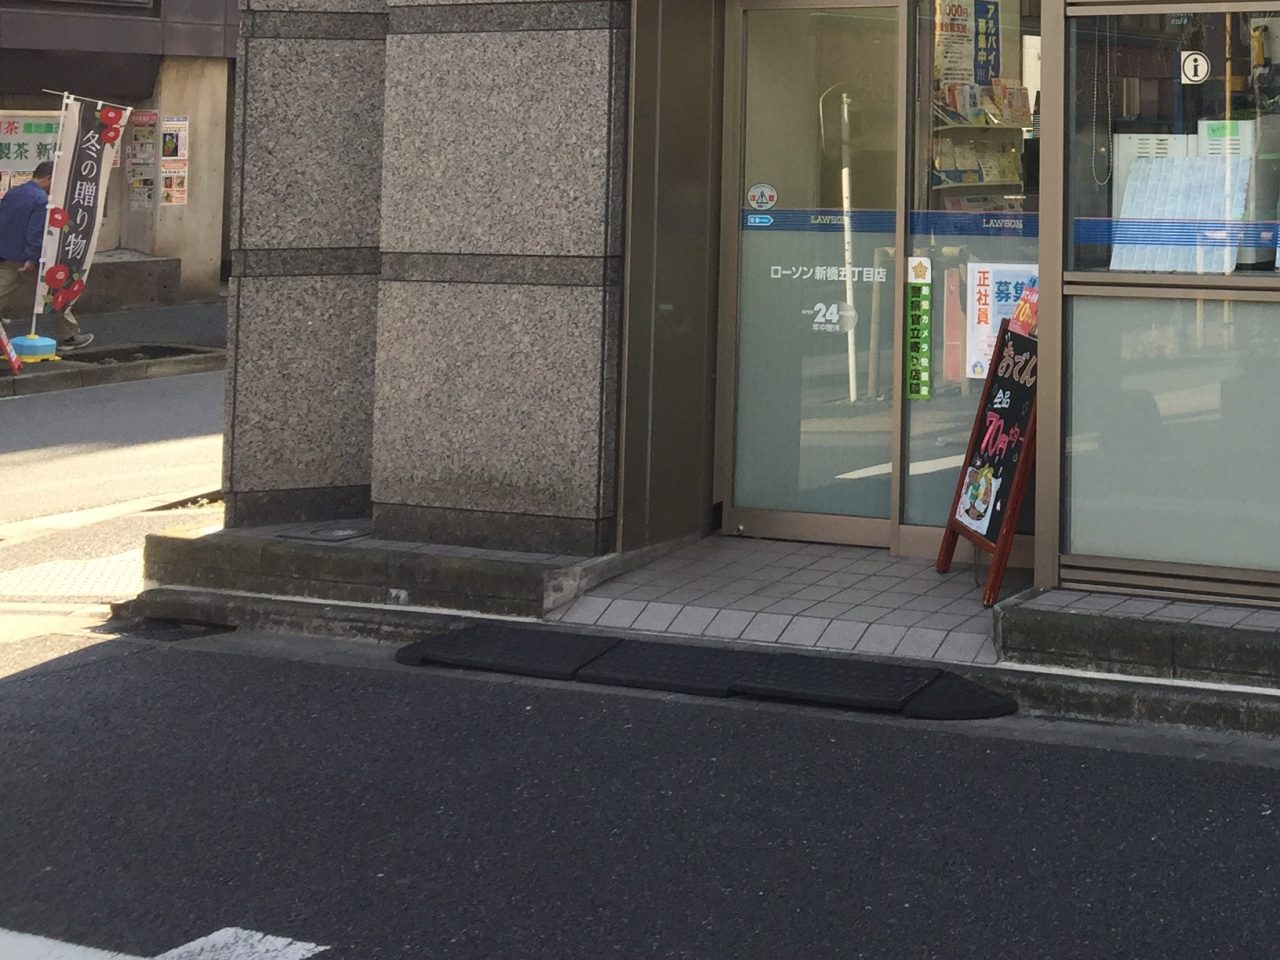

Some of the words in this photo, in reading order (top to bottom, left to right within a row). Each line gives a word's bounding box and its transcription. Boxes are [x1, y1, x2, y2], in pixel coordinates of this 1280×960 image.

[65, 129, 101, 260] 冬の贈り物
[982, 218, 1024, 229] LAWSON
[813, 302, 839, 323] 24
[976, 270, 990, 325] 正社員
[997, 340, 1038, 388] おでん
